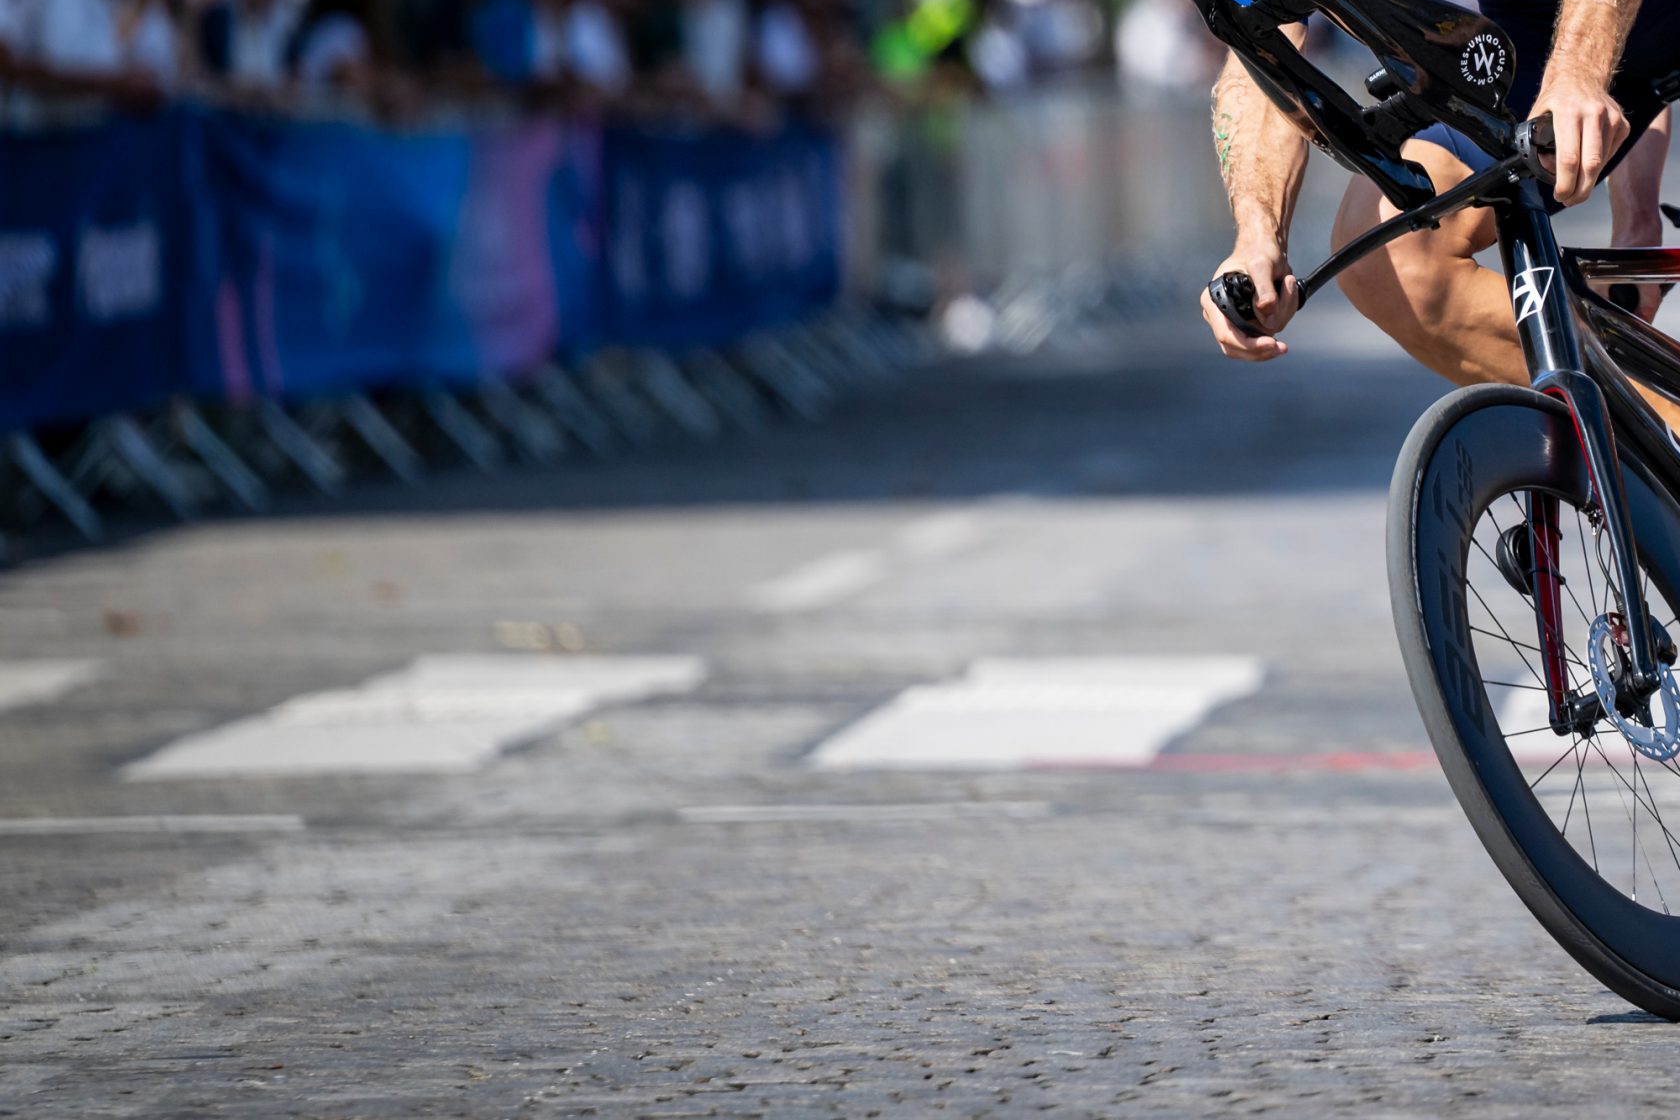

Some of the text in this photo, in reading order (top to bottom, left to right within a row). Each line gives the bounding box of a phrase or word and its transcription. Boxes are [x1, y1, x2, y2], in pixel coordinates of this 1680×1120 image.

[1460, 34, 1506, 85] UNIQO CUSTOM BIKES
